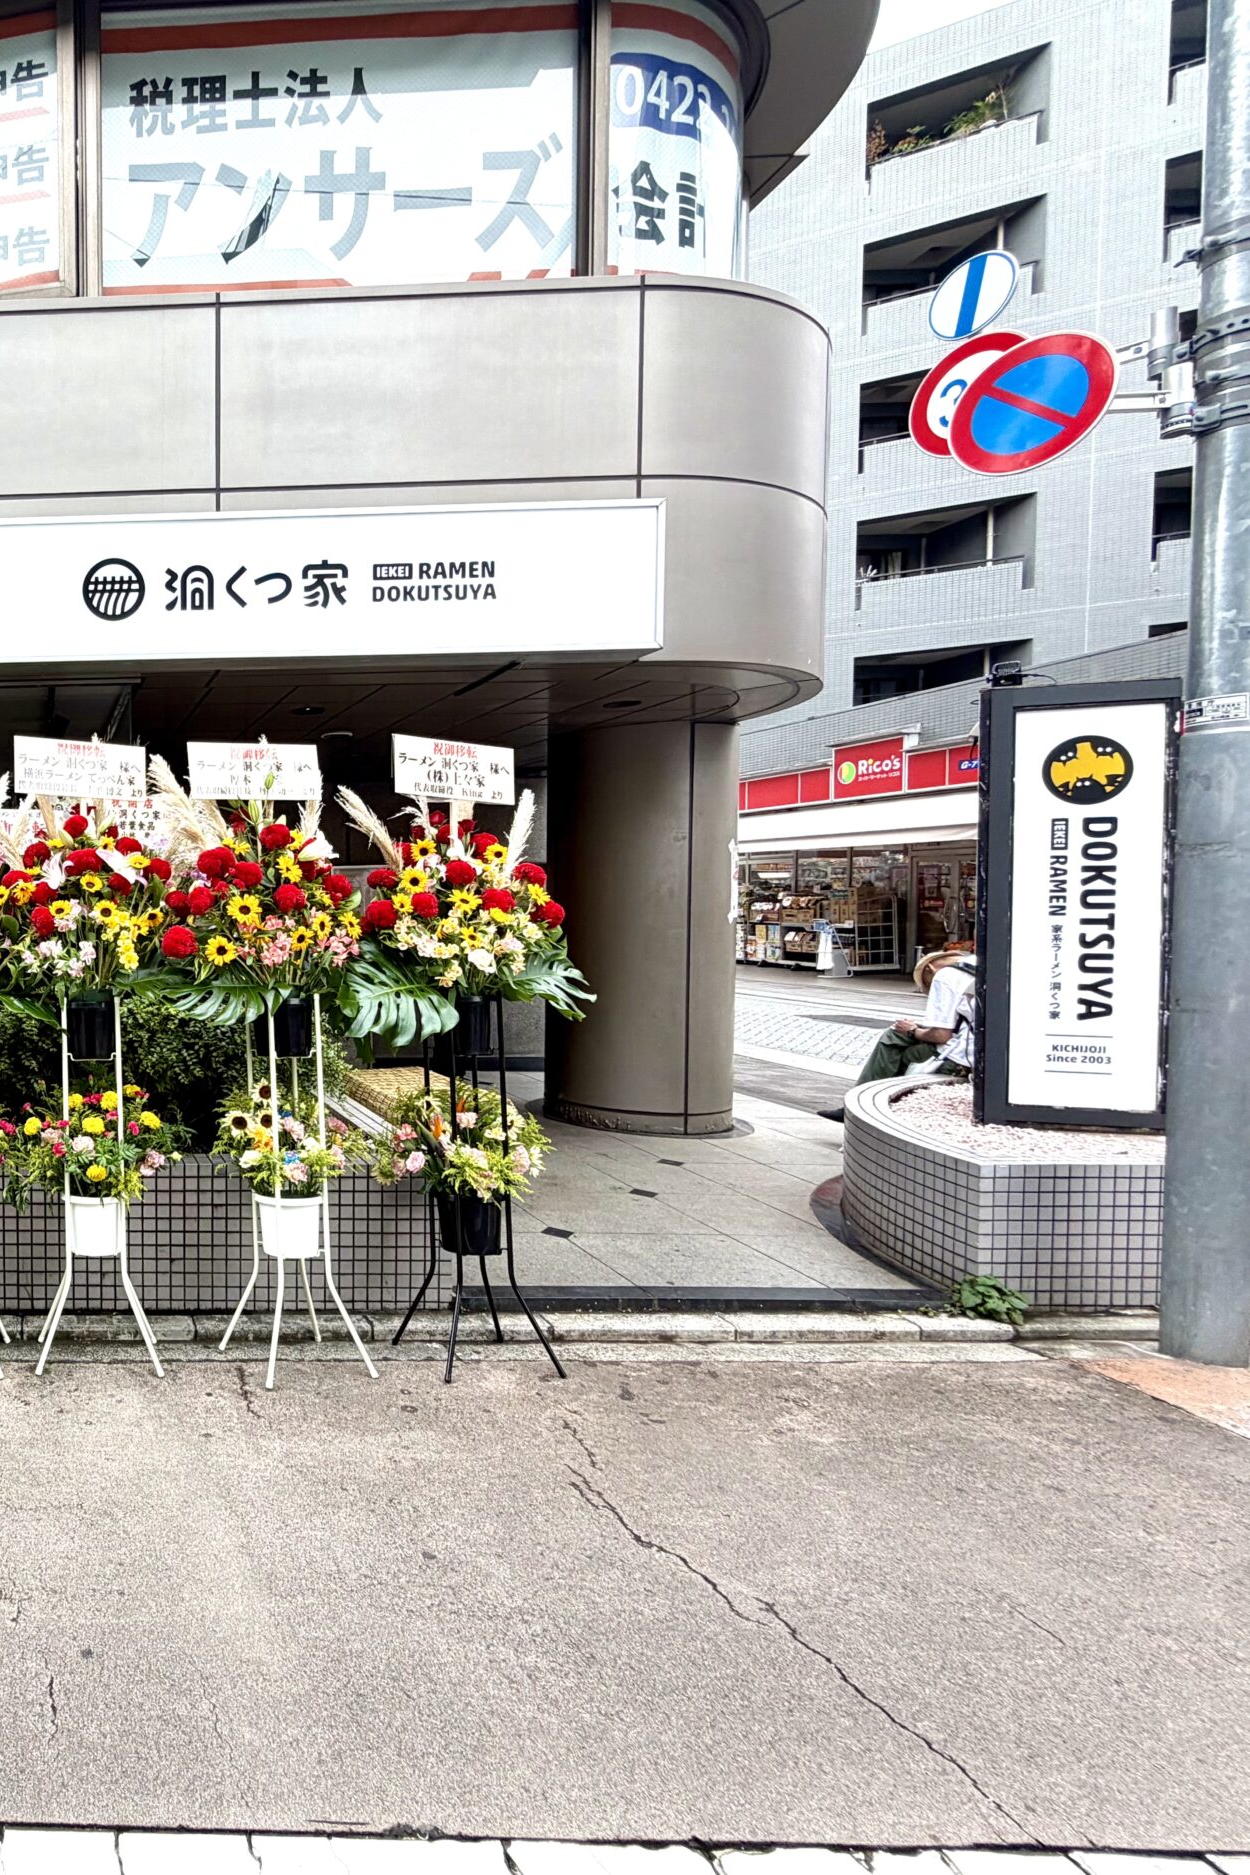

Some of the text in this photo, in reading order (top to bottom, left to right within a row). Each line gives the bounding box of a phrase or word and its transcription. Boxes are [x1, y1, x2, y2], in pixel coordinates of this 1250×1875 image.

[128, 67, 383, 138] 税理士法人
[128, 132, 564, 268] アンサーズ
[376, 561, 496, 580] IEKEI RAMEN
[164, 558, 349, 611] 洞くつ家
[372, 583, 497, 602] DOKUTSUYA
[18, 753, 61, 766] ラーメン
[398, 752, 437, 767] ラーメン
[857, 755, 901, 775] Rico's
[1048, 820, 1068, 916] IEKEI RAMEN
[1076, 816, 1118, 1021] DOKUTSUYA
[1051, 1044, 1107, 1054] KICHIJOJI
[1045, 1054, 1112, 1065] Since 2003
